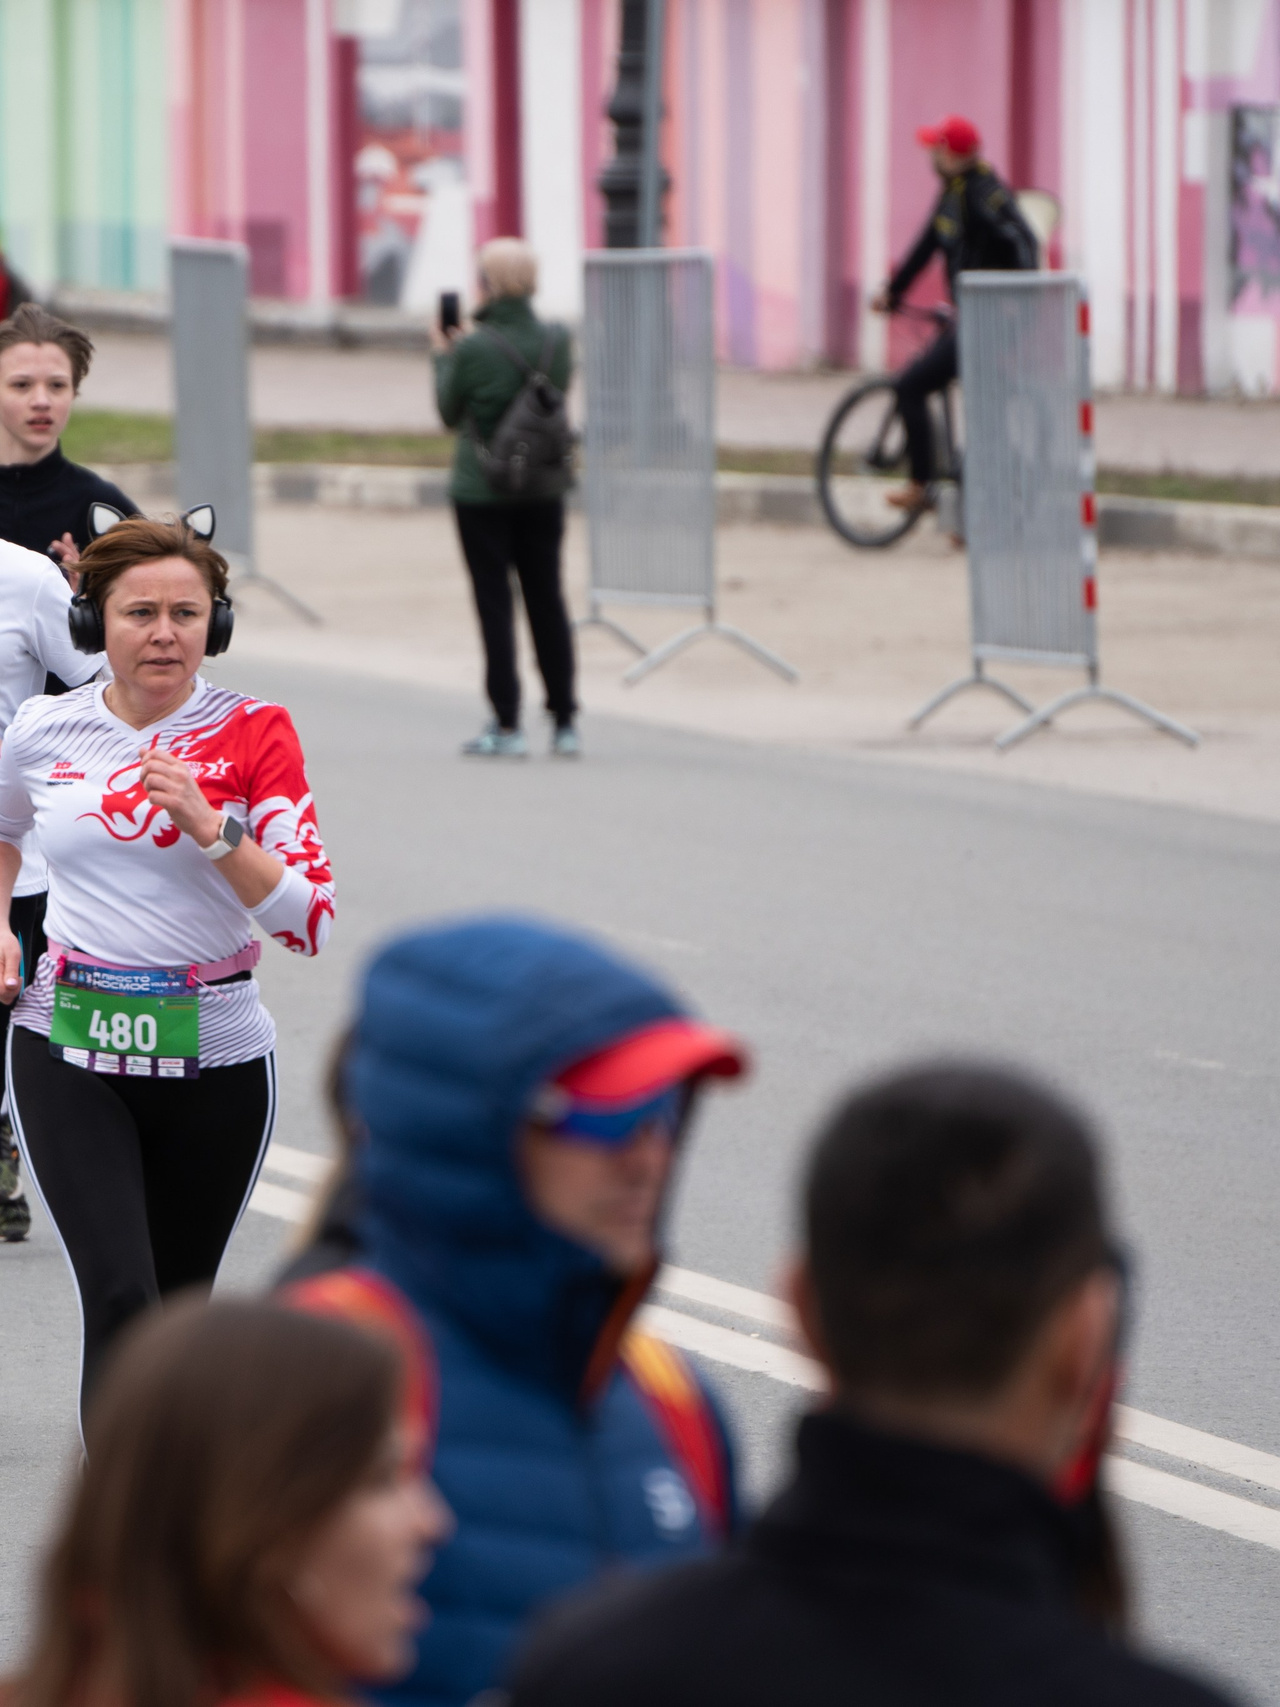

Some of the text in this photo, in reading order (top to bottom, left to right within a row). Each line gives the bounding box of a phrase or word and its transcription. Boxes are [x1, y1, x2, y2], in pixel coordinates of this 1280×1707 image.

[102, 973, 151, 983] ПРОСТО
[92, 979, 151, 991] КОСМОС
[88, 1009, 158, 1052] 480
